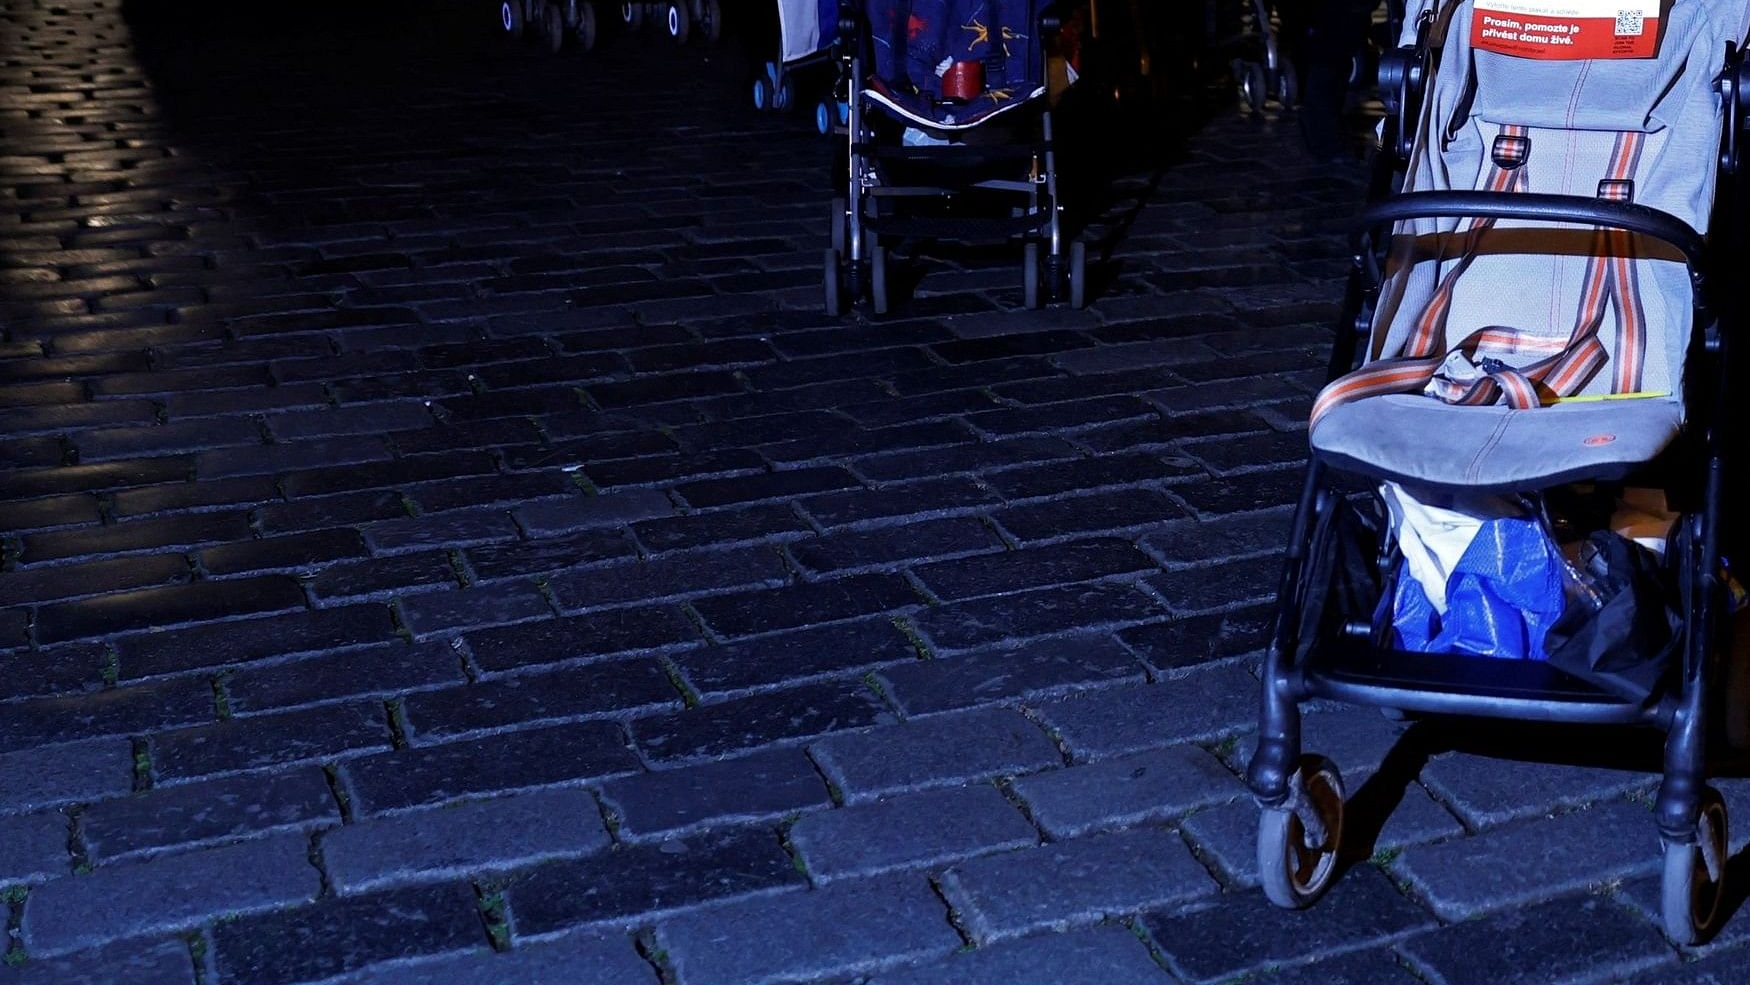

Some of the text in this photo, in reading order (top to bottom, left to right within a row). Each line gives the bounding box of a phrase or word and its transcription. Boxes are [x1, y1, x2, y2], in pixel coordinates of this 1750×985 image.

[1524, 23, 1568, 34] pomozte
[1569, 23, 1580, 34] je
[1482, 28, 1574, 45] přivést domu živé.
